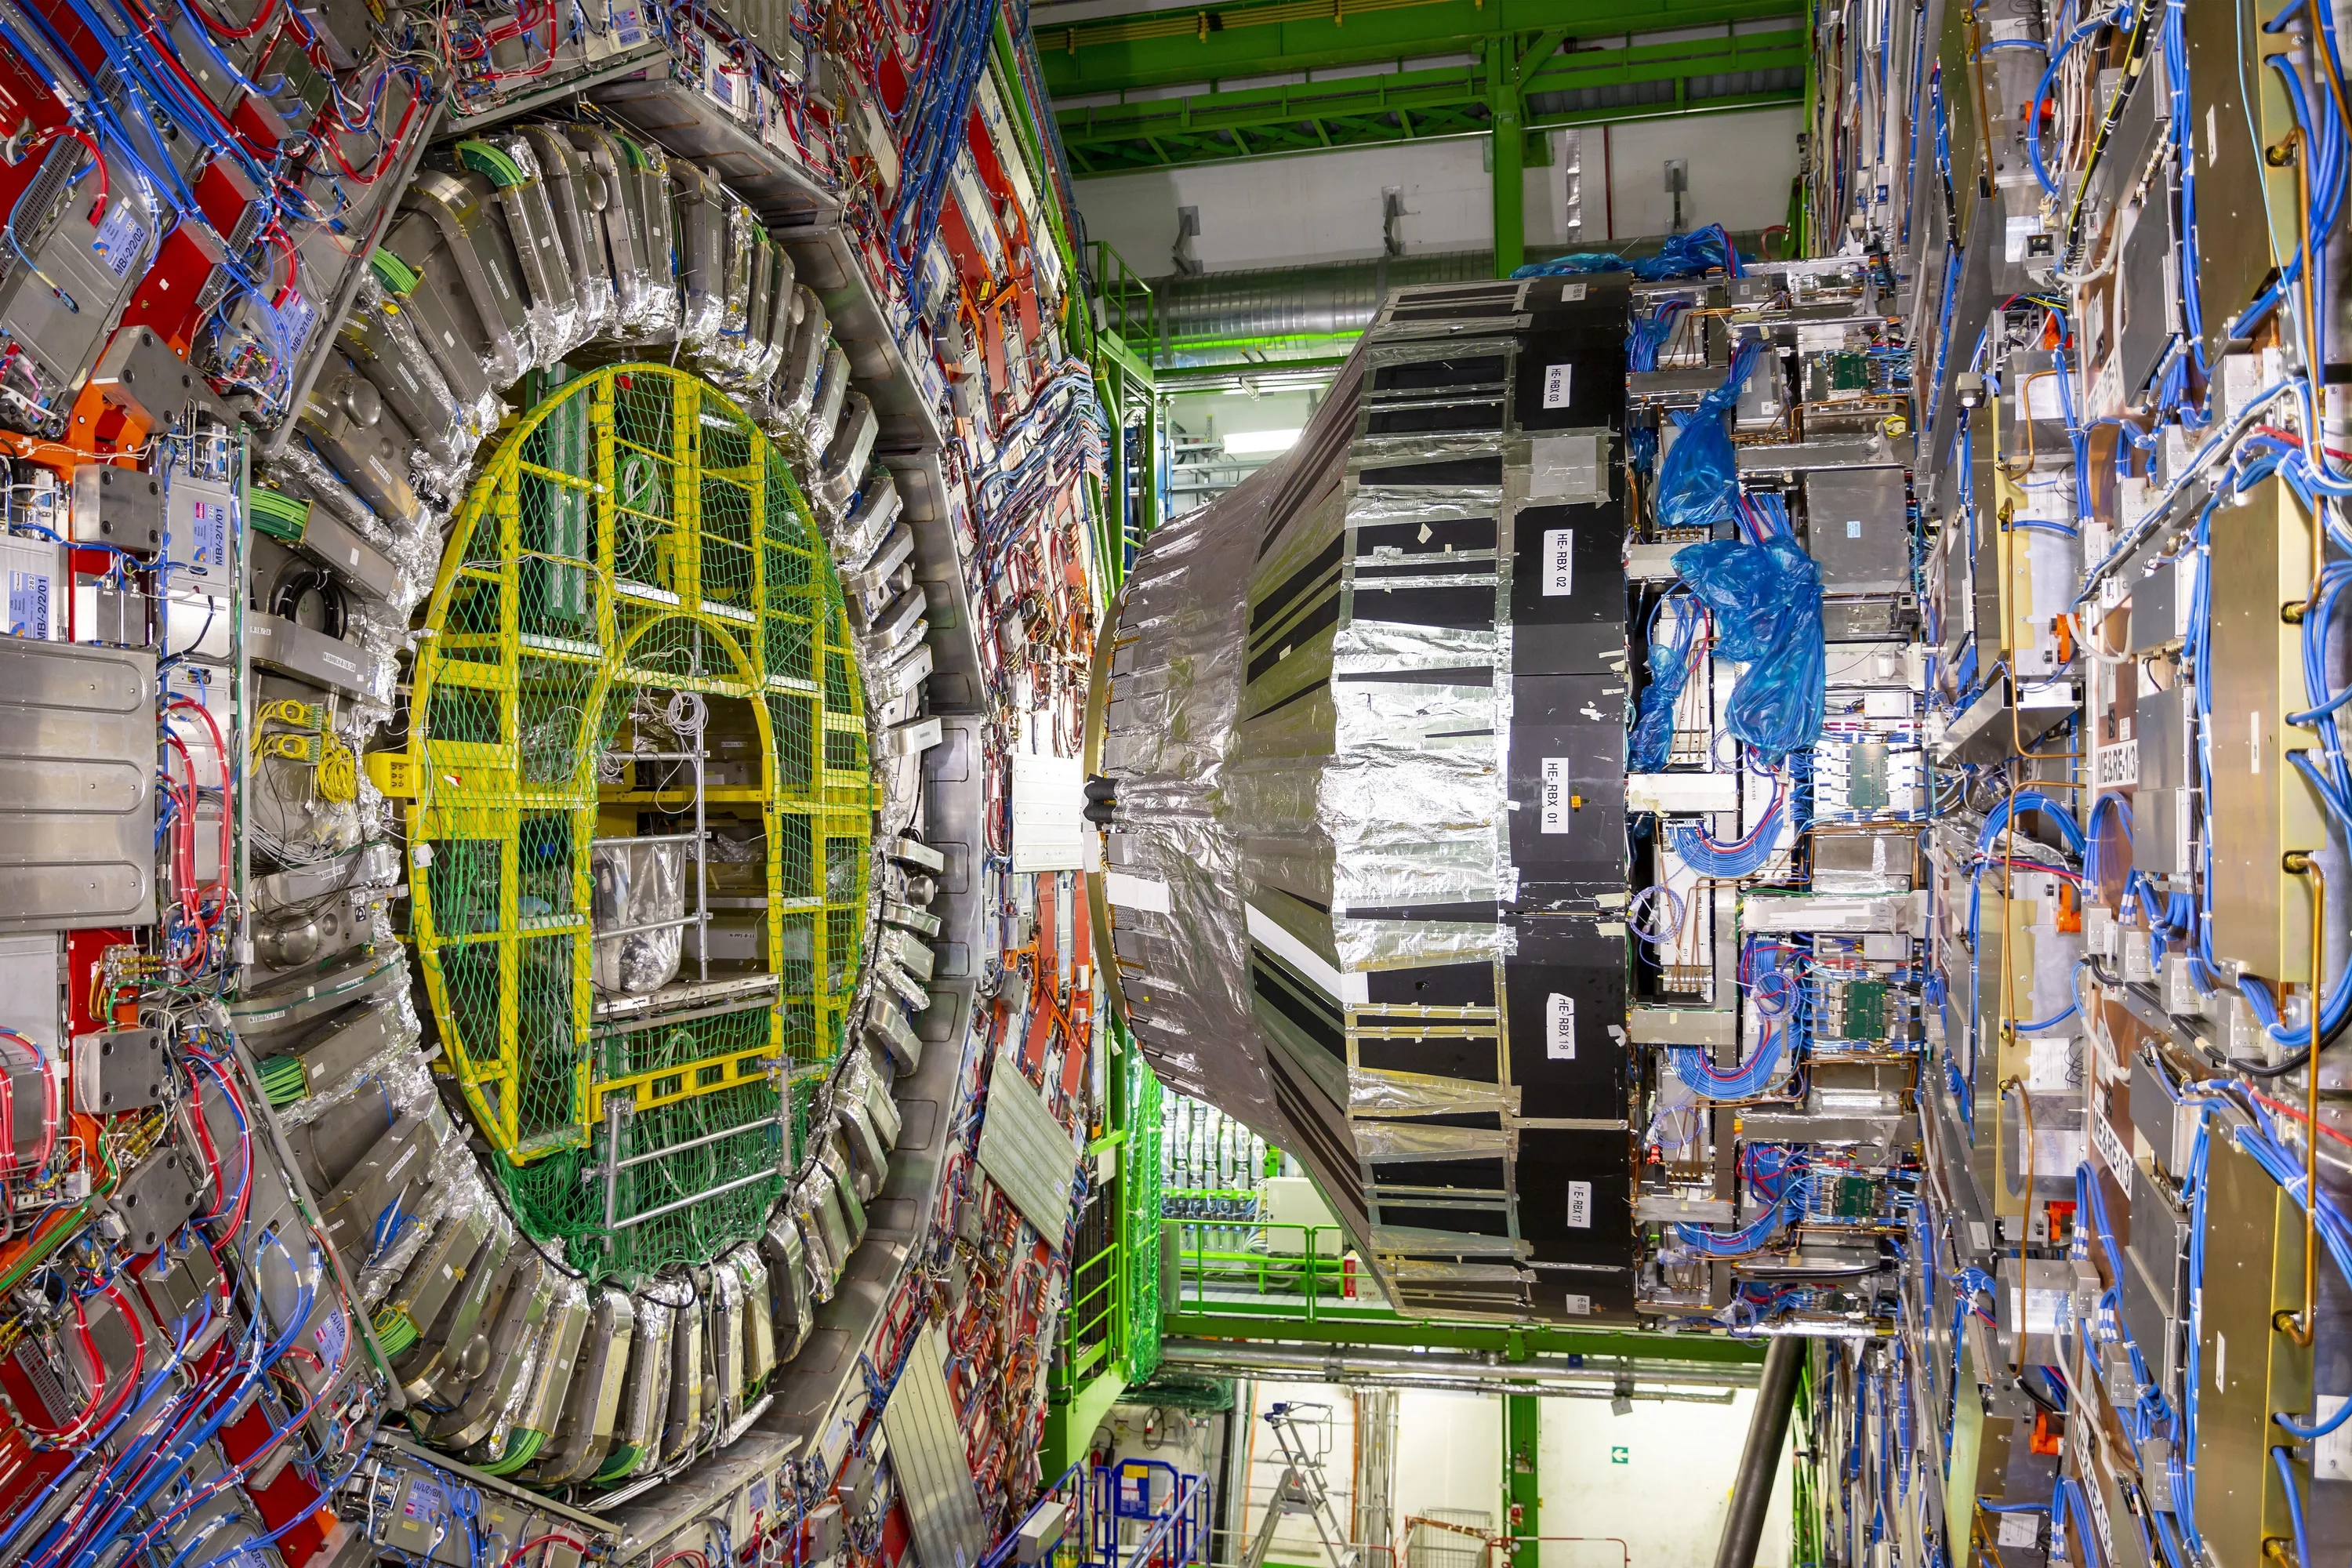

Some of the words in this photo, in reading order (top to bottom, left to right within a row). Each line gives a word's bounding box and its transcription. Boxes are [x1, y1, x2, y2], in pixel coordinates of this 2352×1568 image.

[126, 219, 135, 231] 230
[113, 227, 144, 276] MB/-2/2/02
[289, 307, 316, 353] MB/-2/1/02
[1551, 368, 1561, 379] HE-
[1550, 379, 1560, 393] RBX
[1557, 534, 1568, 549] HE-
[1556, 551, 1567, 572] RBX
[1556, 576, 1566, 587] 02
[37, 579, 46, 639] MB/-2/2/01
[1548, 763, 1558, 781] HE-
[1548, 785, 1558, 807] RBX
[1547, 812, 1558, 823] 01
[1559, 998, 1569, 1014] HE-
[1559, 1018, 1569, 1037] RBX
[1559, 1040, 1569, 1050] 18
[1572, 1200, 1583, 1214] RBX
